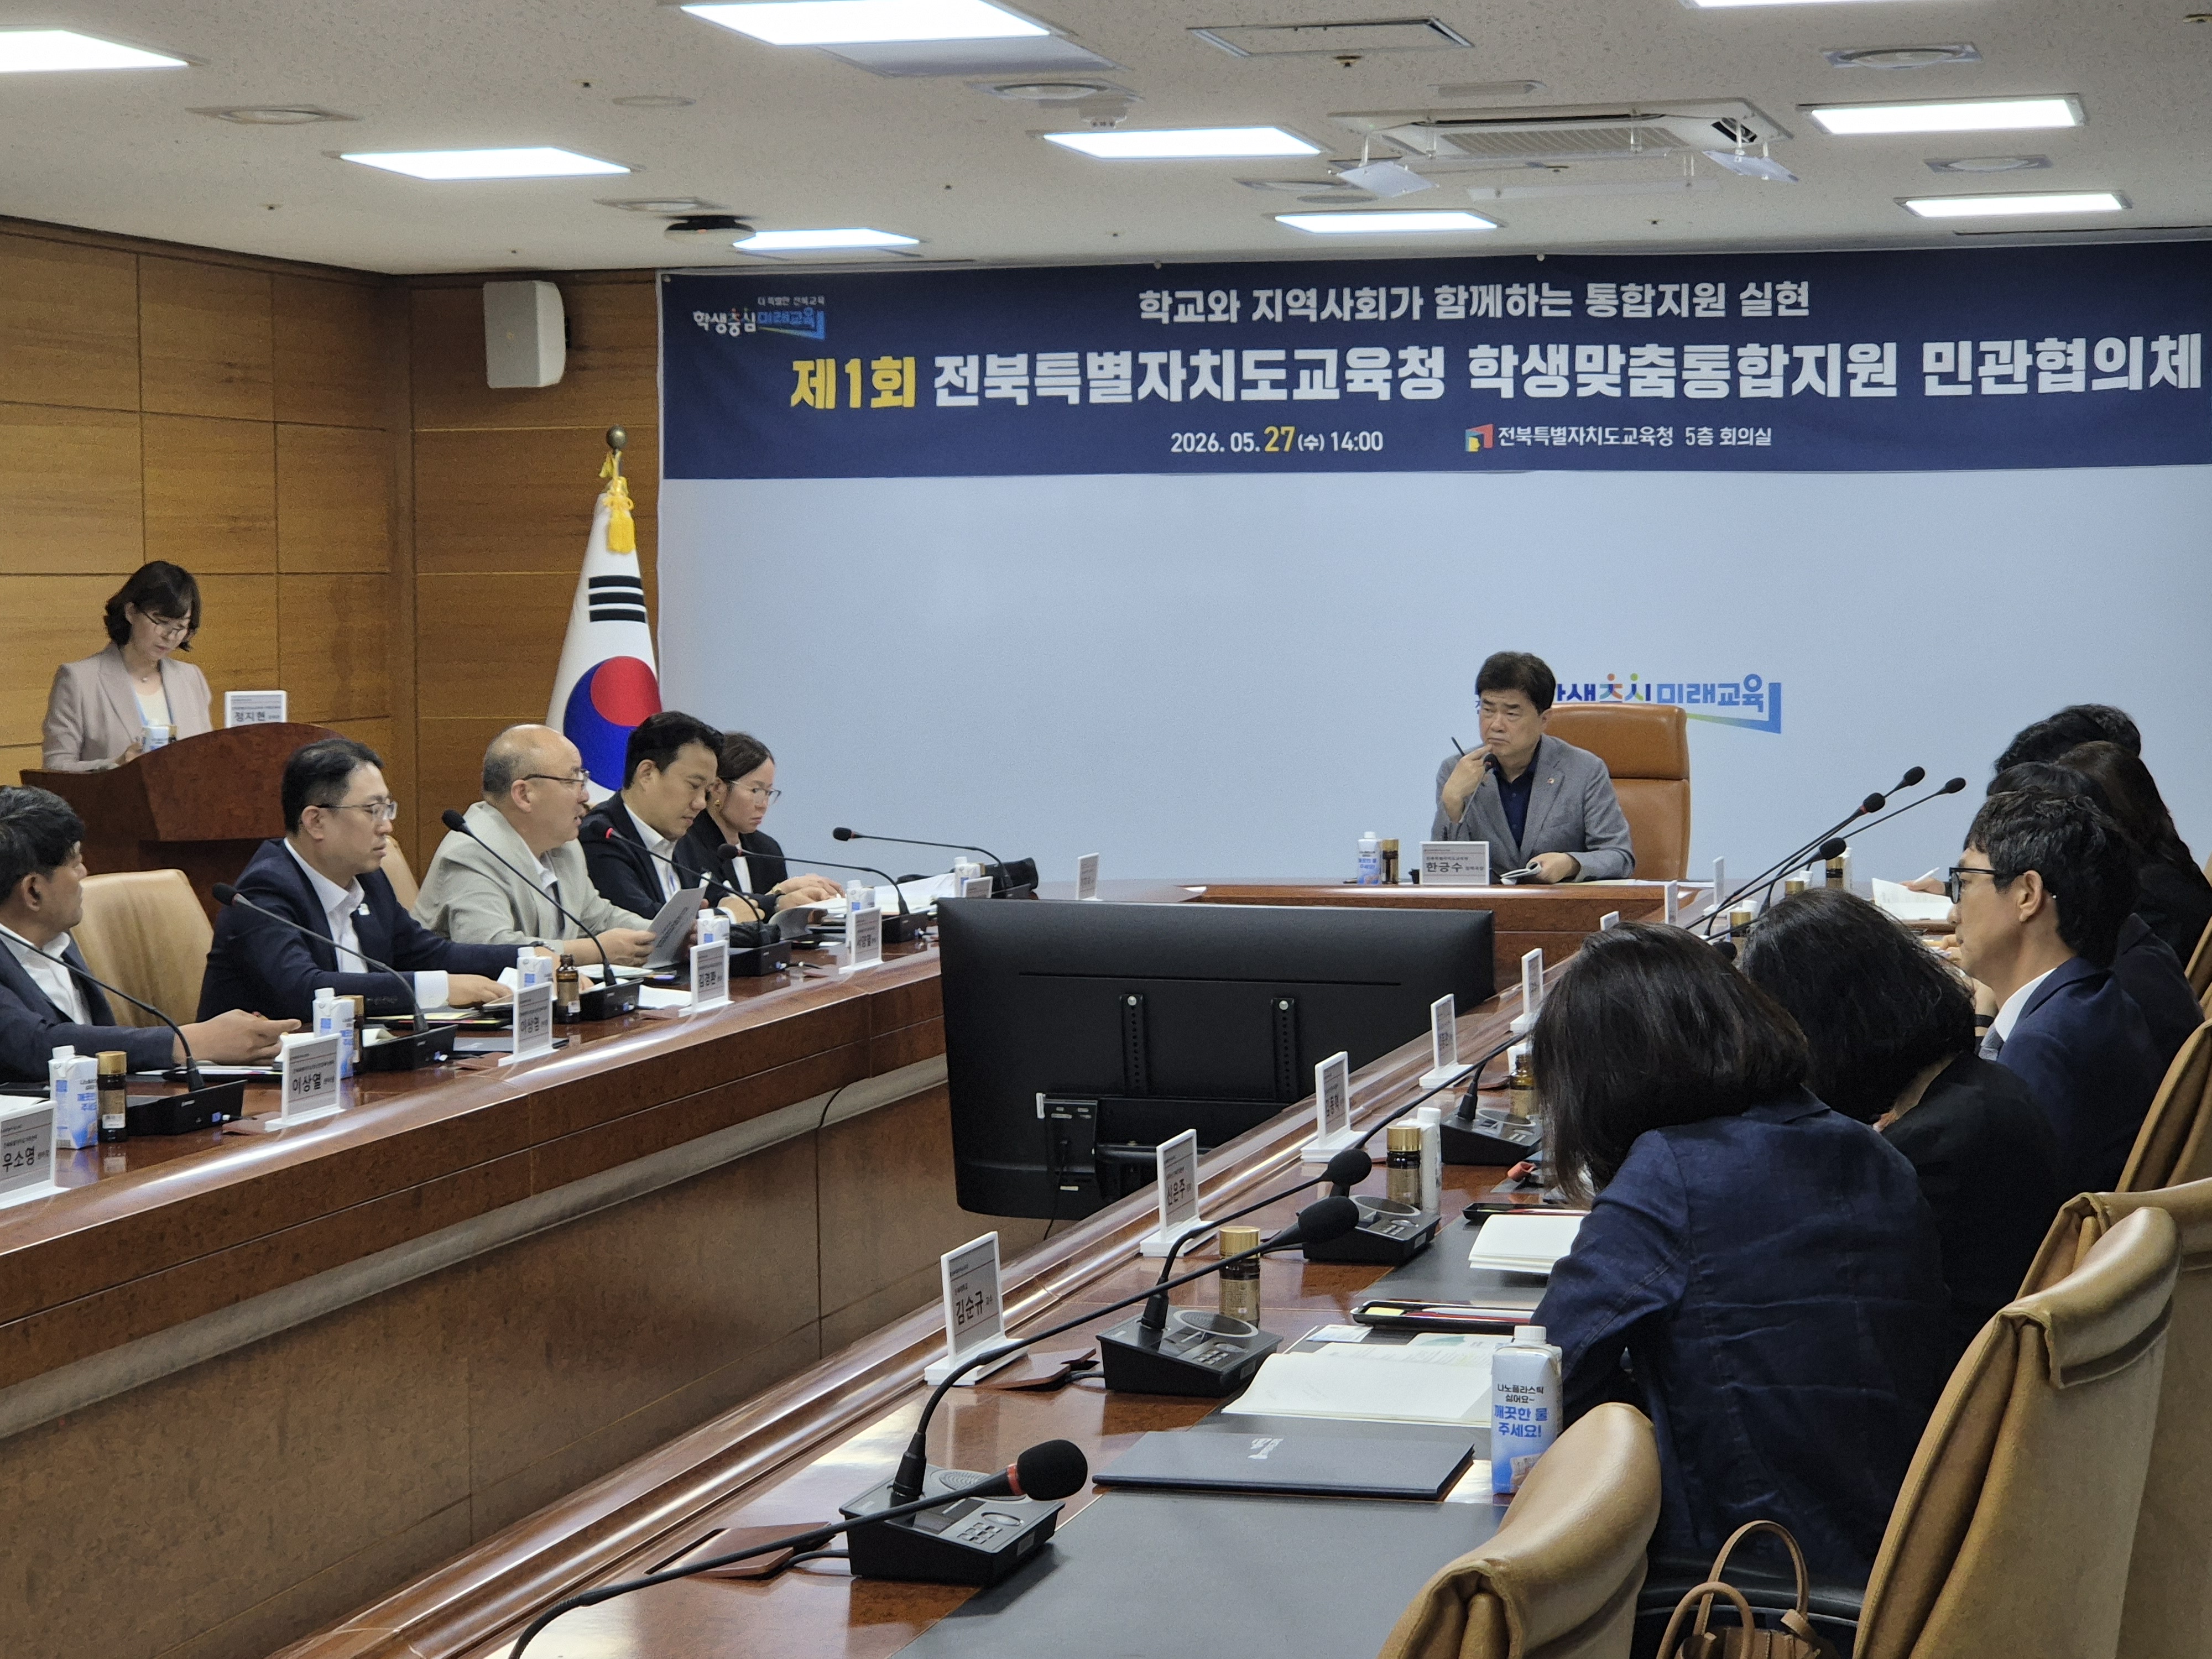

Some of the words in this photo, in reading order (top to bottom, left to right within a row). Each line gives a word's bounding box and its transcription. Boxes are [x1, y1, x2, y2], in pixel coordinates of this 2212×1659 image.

[1139, 289, 1241, 324] 학교와
[1252, 286, 1424, 322] 지역사회가
[1434, 283, 1573, 320] 함께하는
[1585, 282, 1725, 318] 통합지원
[1740, 280, 1809, 317] 실현
[790, 356, 916, 410] 제1회
[933, 345, 1445, 408] 전북특별자치도교육청
[1468, 342, 1897, 399] 학생맞춤통합지원
[1922, 333, 2202, 397] 민관협의체
[1170, 432, 1226, 453] 2026.
[1331, 430, 1384, 452] 14:00
[1498, 425, 1673, 447] 전북특별자치도교육청
[1685, 426, 1714, 446] 5층
[1719, 426, 1772, 447] 회의실
[1657, 673, 1764, 713] 미래교육
[1426, 862, 1463, 873] 한긍수
[292, 1073, 321, 1095] 이상열
[2, 1146, 35, 1172] 우소영
[956, 1290, 984, 1326] 김순규
[1497, 1384, 1545, 1395] 나노플라스틱
[1494, 1405, 1531, 1421] 깨끗한
[1535, 1407, 1548, 1421] 물
[1498, 1422, 1542, 1438] 주세요!
